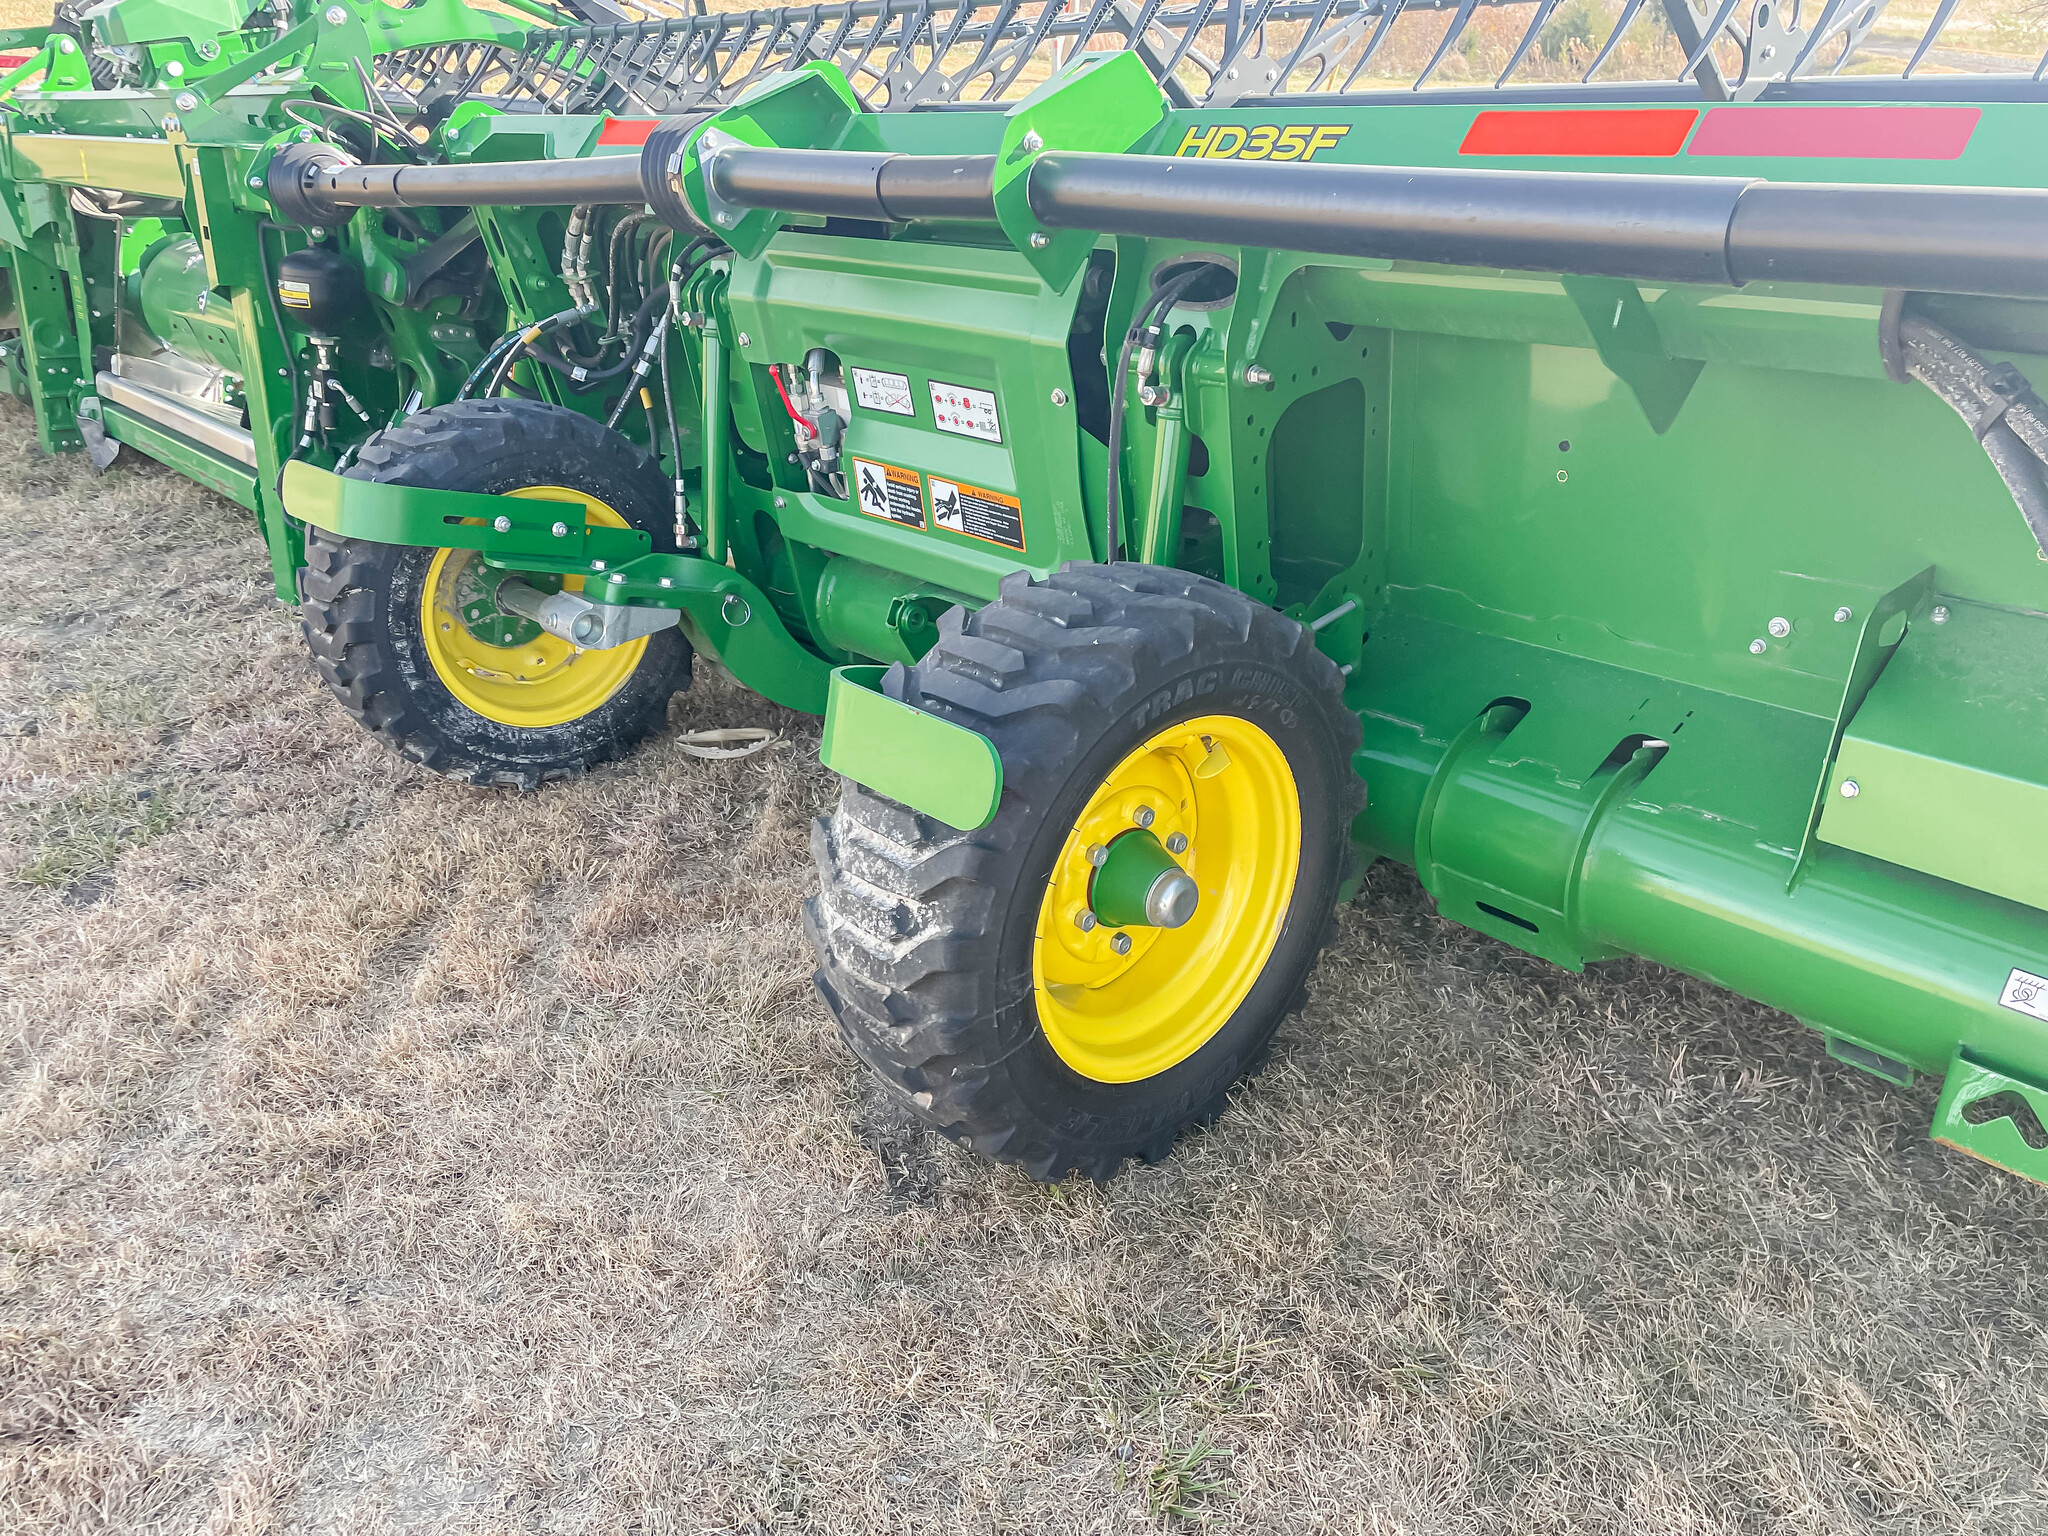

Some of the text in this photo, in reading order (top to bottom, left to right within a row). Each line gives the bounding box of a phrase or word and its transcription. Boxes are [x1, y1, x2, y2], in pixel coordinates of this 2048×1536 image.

[1173, 124, 1353, 162] HD35F
[891, 471, 919, 484] WARNING
[978, 492, 1004, 504] WARNING
[1131, 671, 1218, 731] TRAC
